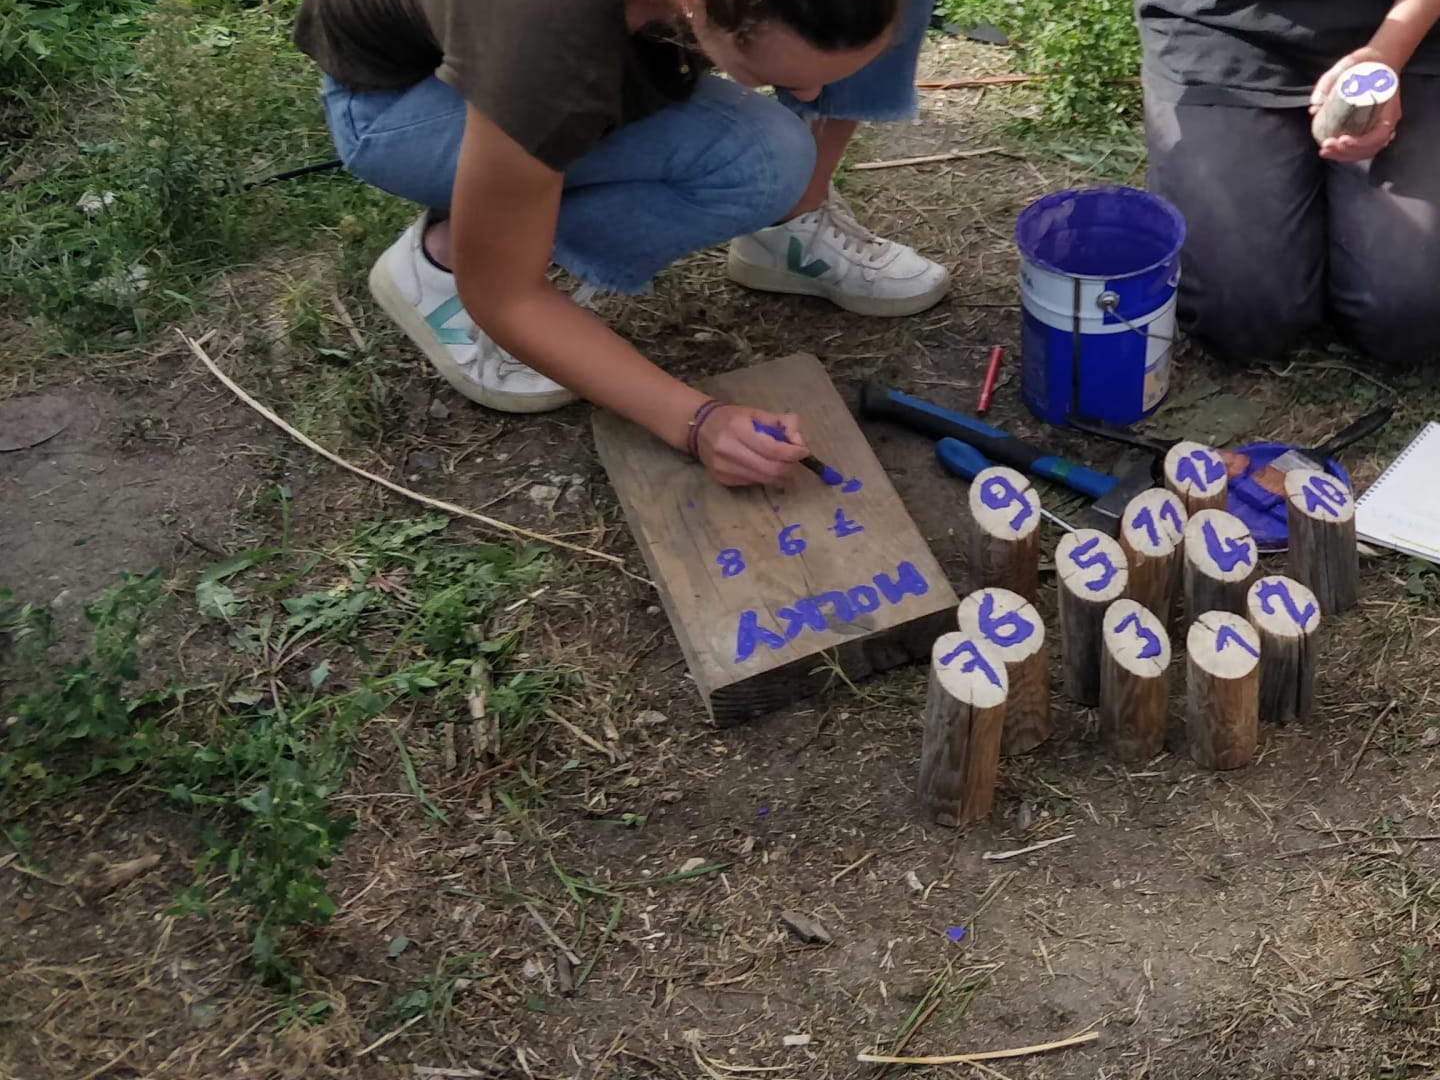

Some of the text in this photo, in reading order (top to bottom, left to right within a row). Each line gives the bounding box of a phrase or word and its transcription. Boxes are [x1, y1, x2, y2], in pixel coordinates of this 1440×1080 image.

[1341, 68, 1395, 98] 8
[1175, 446, 1226, 494] 12
[979, 474, 1034, 532] 9
[1301, 474, 1347, 518] 10
[1131, 497, 1183, 547] 11
[1201, 517, 1252, 573] 4
[716, 547, 746, 579] 8
[1069, 536, 1118, 592] 5
[977, 592, 1035, 648] 6
[1256, 580, 1317, 627] 2
[1114, 612, 1162, 660] 3
[1215, 624, 1260, 658] 1
[939, 639, 1004, 689] 7
